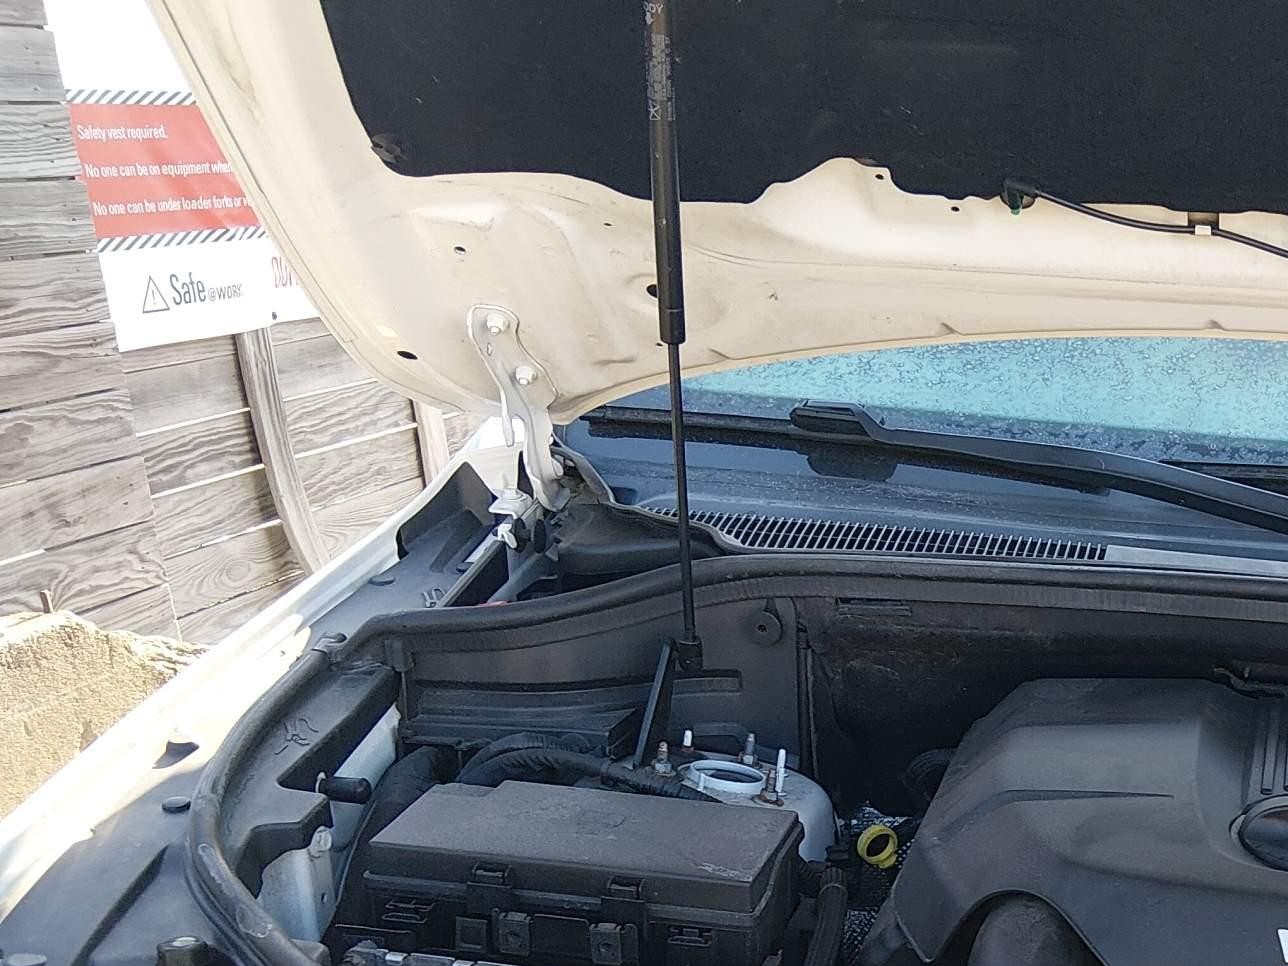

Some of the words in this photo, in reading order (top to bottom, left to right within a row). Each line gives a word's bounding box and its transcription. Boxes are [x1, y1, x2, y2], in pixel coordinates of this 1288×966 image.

[76, 124, 106, 142] Safety
[107, 126, 127, 139] vest
[127, 124, 168, 141] required.
[84, 162, 99, 178] No
[101, 166, 118, 177] one
[120, 165, 136, 176] can
[136, 162, 148, 176] be
[149, 165, 161, 175] on
[161, 160, 211, 178] equipment
[92, 201, 107, 216] No
[109, 203, 125, 215] one
[127, 202, 144, 213] can
[144, 199, 156, 212] be
[157, 197, 181, 212] under
[182, 196, 212, 210] loader
[212, 195, 233, 209] forks
[233, 197, 242, 207] or
[169, 272, 207, 306] Safe
